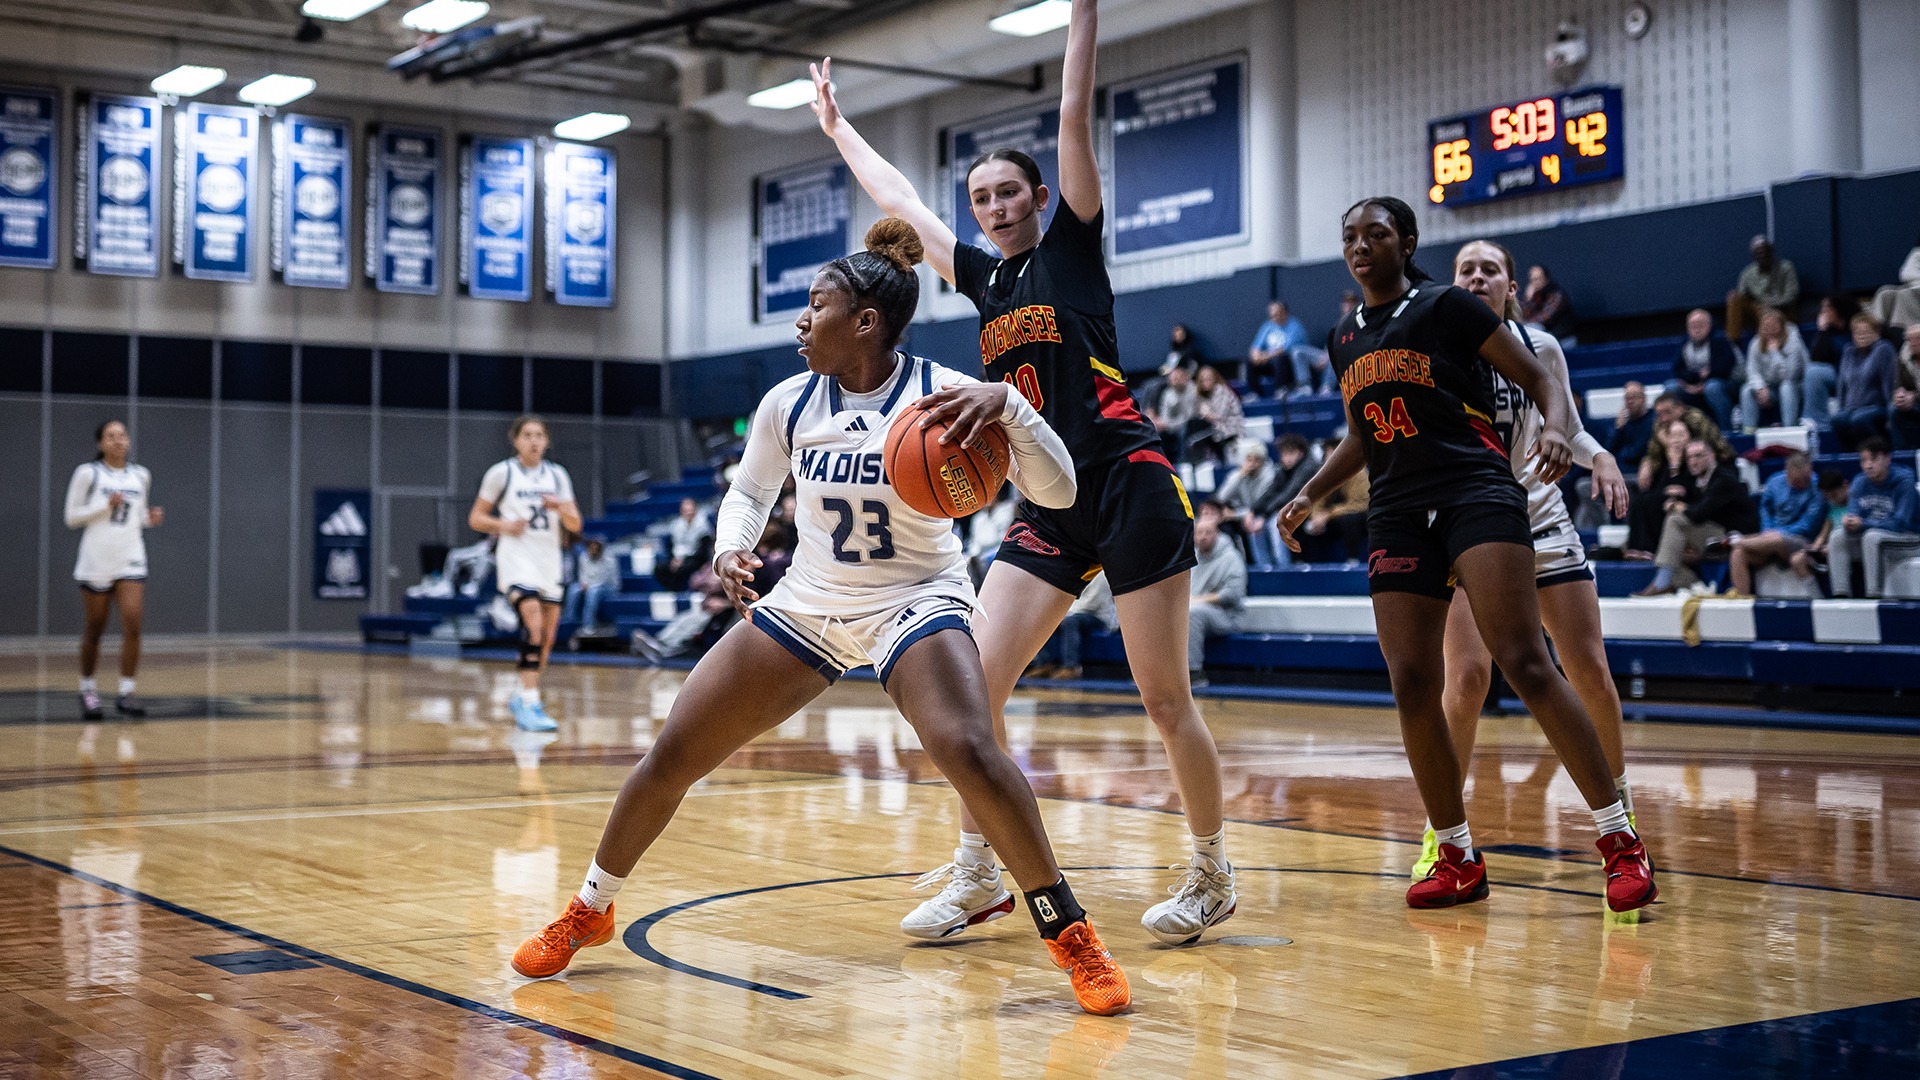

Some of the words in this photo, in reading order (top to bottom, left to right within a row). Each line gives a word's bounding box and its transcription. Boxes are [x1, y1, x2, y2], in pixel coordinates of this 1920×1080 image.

[1490, 97, 1556, 151] 5:03
[1565, 112, 1607, 156] 42
[1433, 138, 1473, 185] 66
[1540, 154, 1560, 184] 4
[1002, 363, 1045, 412] 0
[1363, 396, 1419, 444] 34
[798, 448, 891, 485] MADIS
[946, 453, 979, 509] LEGAC
[821, 497, 897, 563] 23
